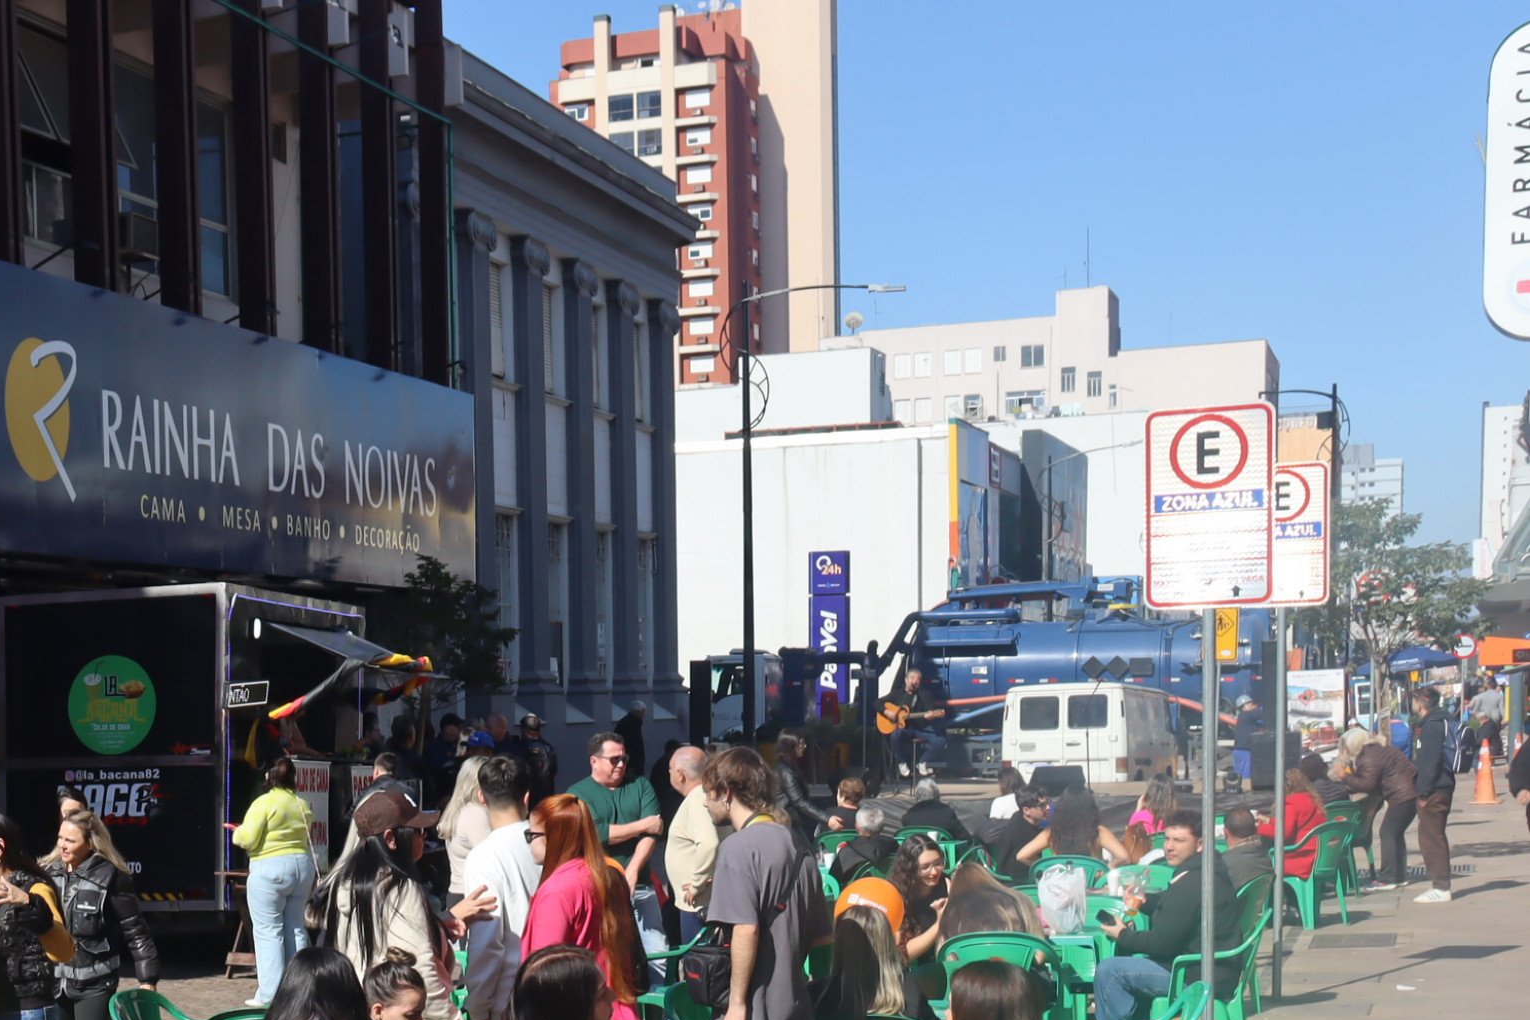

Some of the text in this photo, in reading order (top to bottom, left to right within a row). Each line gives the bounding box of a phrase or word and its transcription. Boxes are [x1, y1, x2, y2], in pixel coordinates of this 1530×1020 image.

[101, 388, 438, 518] RAINHA DAS NOIVAS
[1197, 431, 1220, 475] E
[1161, 490, 1260, 512] ZONA AZUL
[141, 494, 421, 556] CAMA MESA BANHO DECORAÇÃO
[1285, 523, 1318, 538] AZUL
[821, 564, 842, 575] 24h
[75, 768, 160, 782] @la_bacana82
